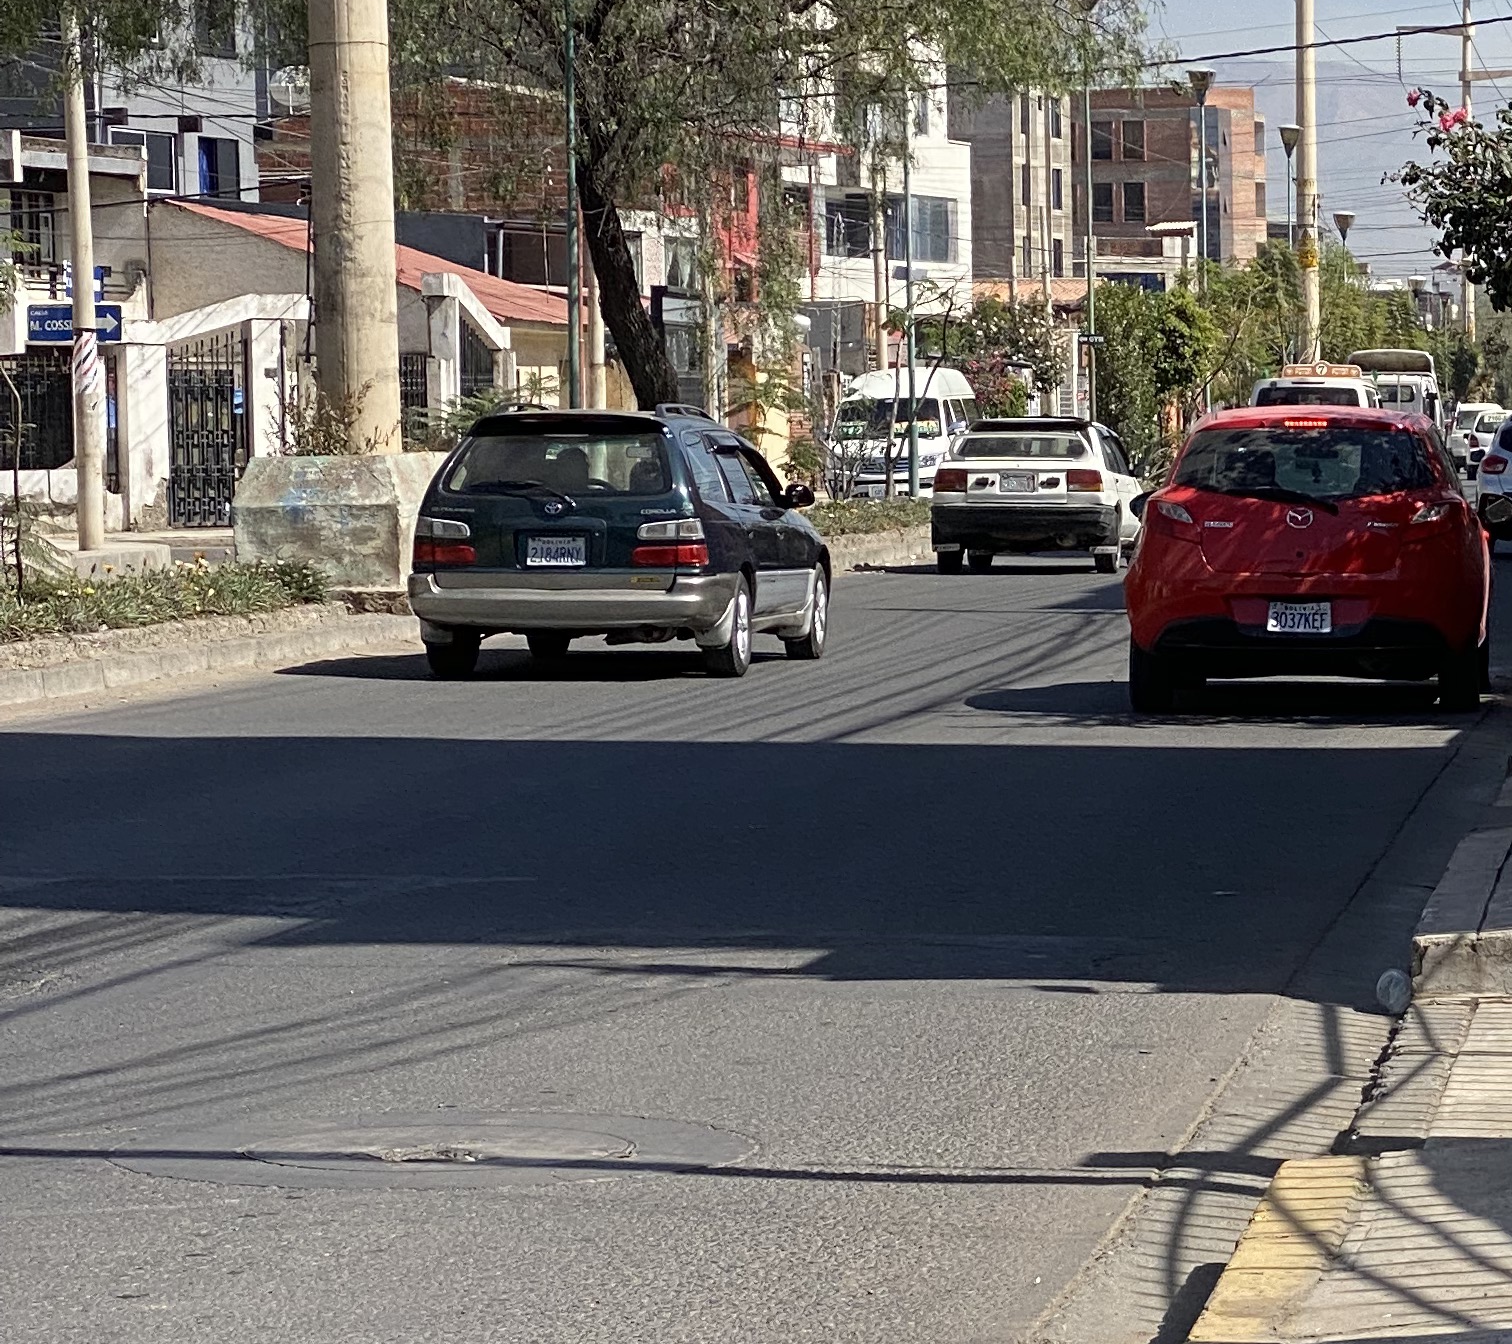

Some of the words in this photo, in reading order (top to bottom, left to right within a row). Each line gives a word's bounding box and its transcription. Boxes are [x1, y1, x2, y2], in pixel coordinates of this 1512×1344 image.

[30, 320, 43, 331] M.
[44, 319, 73, 332] COSSI
[1317, 365, 1325, 375] 7
[1271, 611, 1328, 630] 3037KEF
